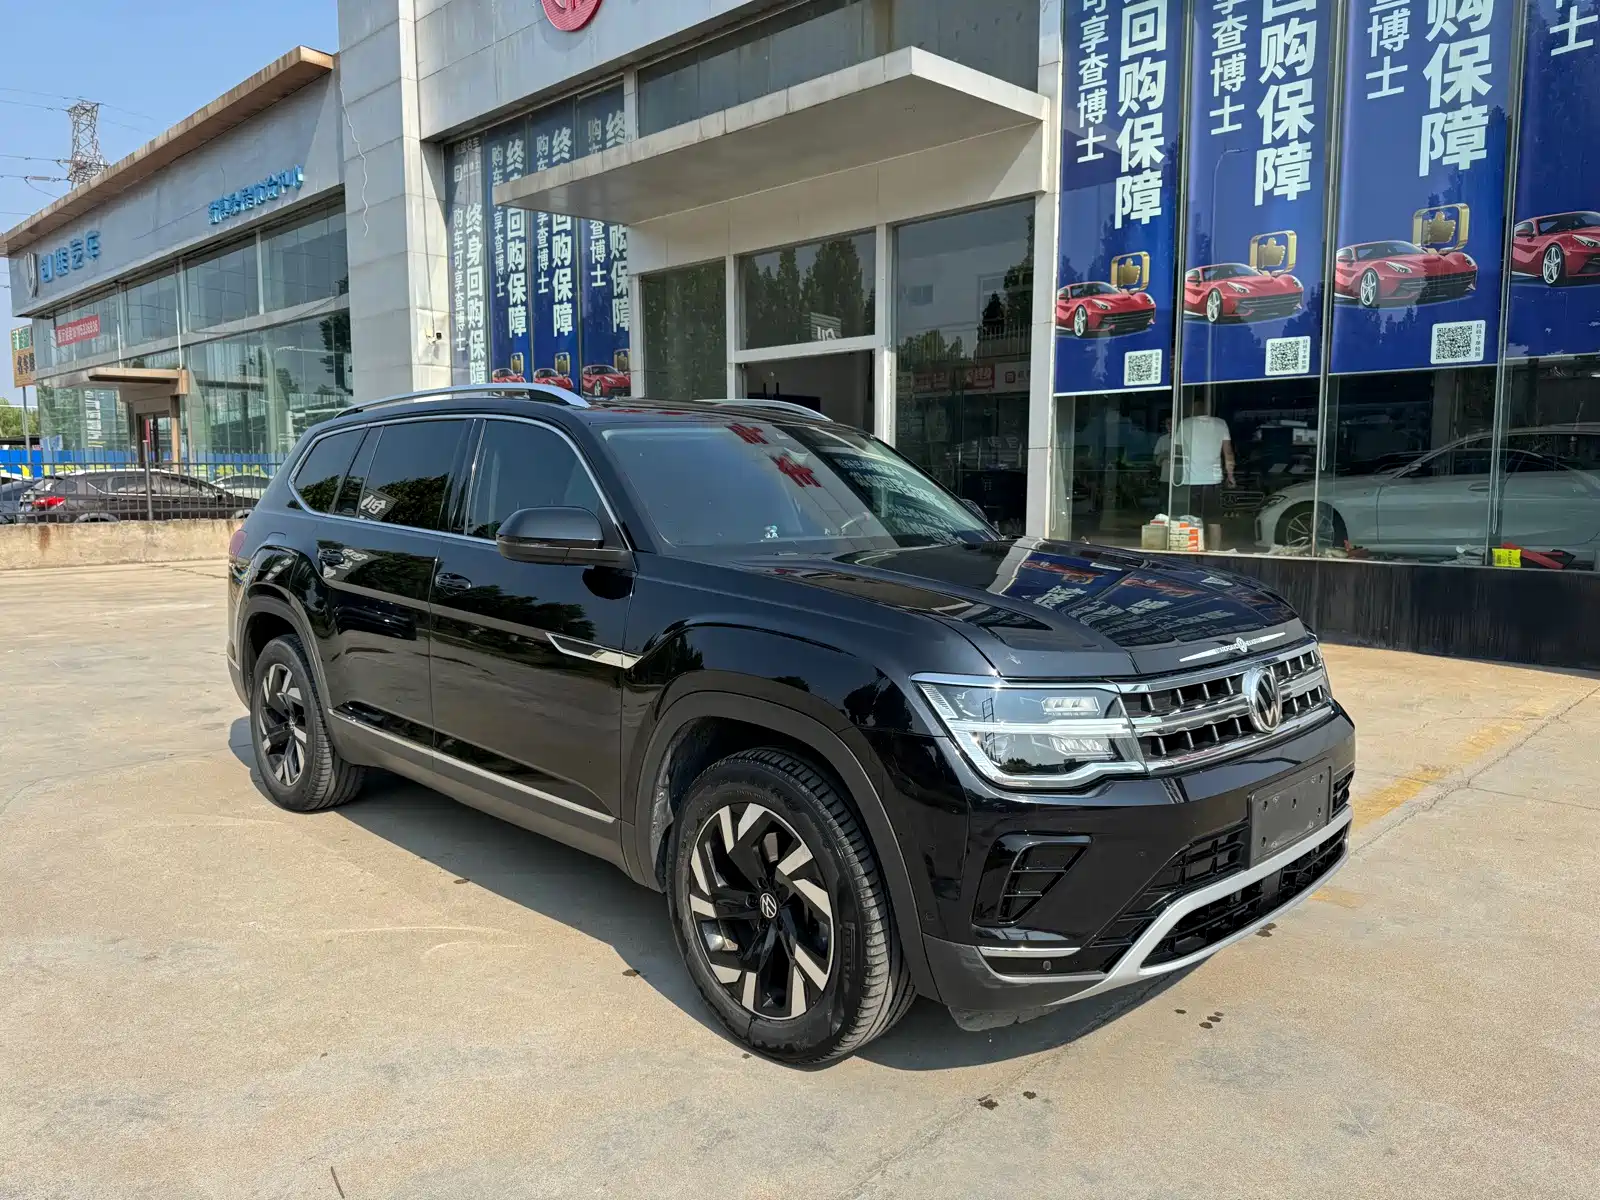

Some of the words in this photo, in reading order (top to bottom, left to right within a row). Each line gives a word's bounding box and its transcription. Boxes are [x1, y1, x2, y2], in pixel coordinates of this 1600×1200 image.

[1114, 0, 1168, 229] 回购保障
[1365, 0, 1411, 100] 博士
[453, 208, 466, 352] 购车可享查博士
[465, 203, 486, 385] 终身回购保障
